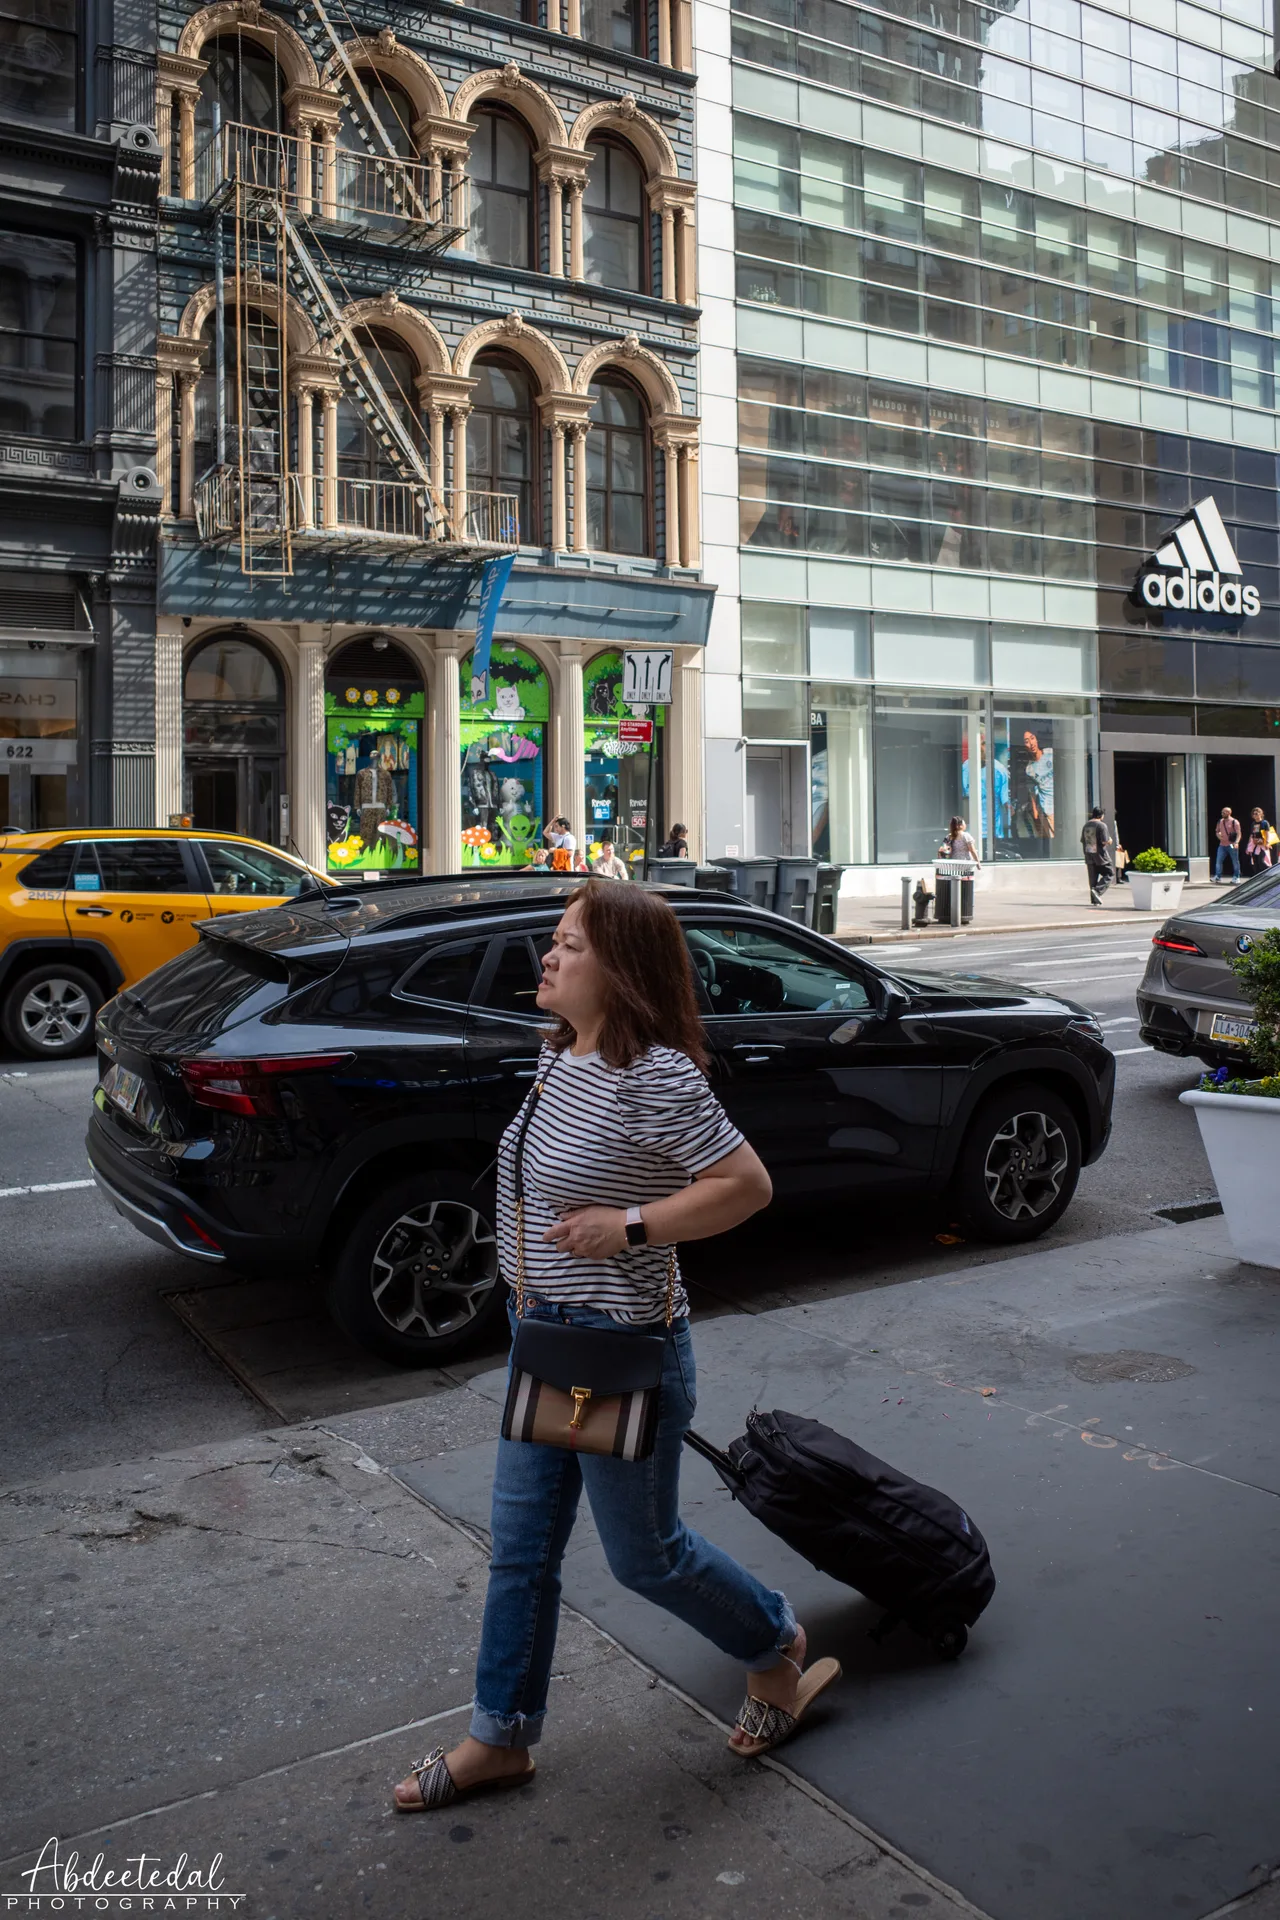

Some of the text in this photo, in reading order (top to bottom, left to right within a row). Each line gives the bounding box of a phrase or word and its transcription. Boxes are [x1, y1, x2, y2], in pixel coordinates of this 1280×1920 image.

[929, 408, 958, 420] THONY
[962, 414, 1000, 428] EDWDS
[1143, 567, 1261, 616] adidas
[626, 691, 636, 700] ONLY
[641, 691, 651, 700] ONLY
[656, 691, 666, 700] ONLY
[6, 745, 33, 758] 622
